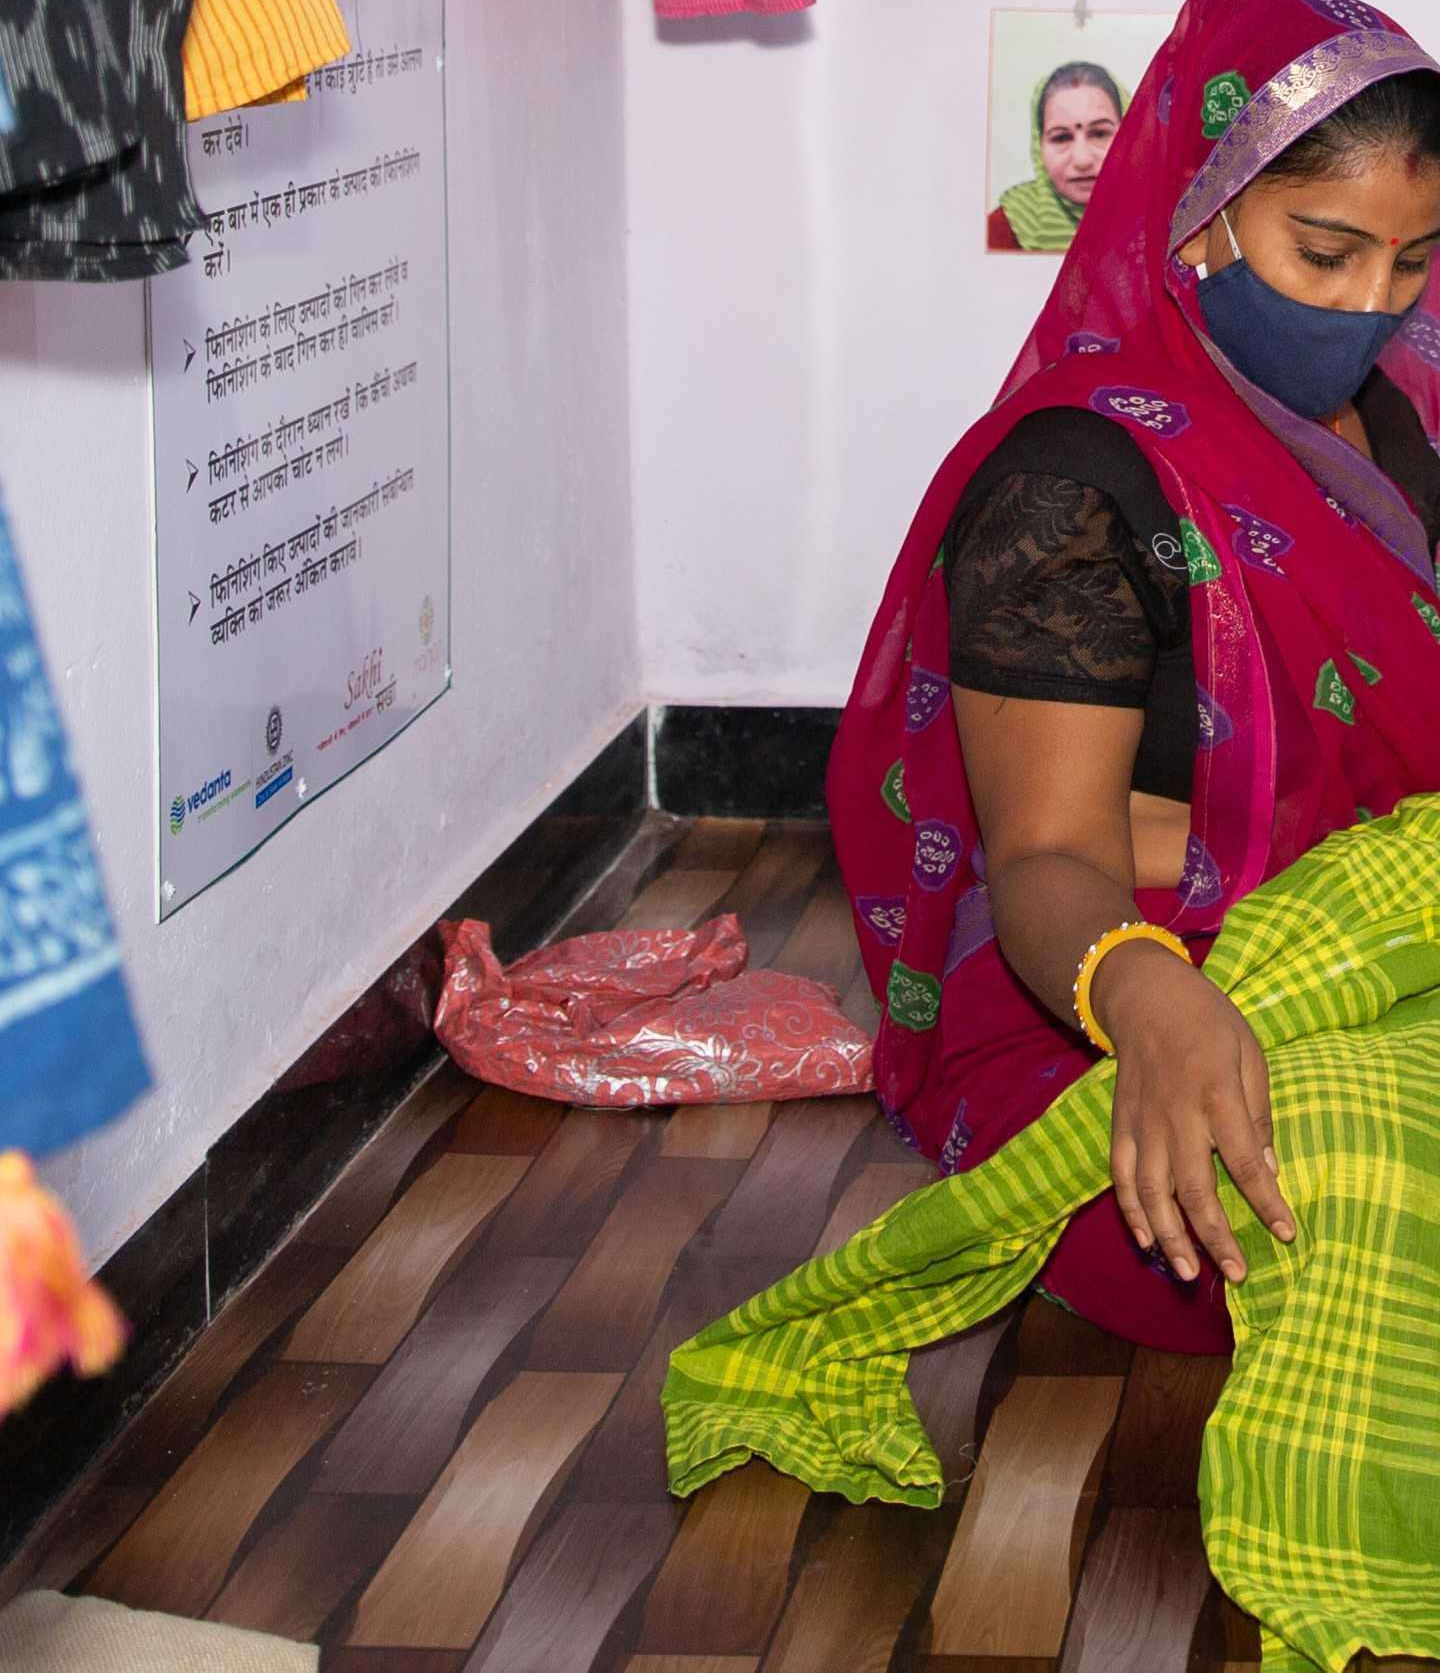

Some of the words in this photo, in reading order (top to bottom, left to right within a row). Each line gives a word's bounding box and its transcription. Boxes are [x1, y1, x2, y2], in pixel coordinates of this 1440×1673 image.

[202, 132, 222, 157] कर
[228, 204, 247, 231] बार
[250, 191, 260, 225] में
[262, 197, 281, 227] एक
[284, 182, 296, 218] ही
[298, 182, 327, 212] प्रकार
[330, 170, 340, 200] के
[369, 157, 381, 186] की
[205, 314, 257, 363] फिनिशिंग
[260, 306, 271, 337] के
[274, 303, 296, 336] लिए
[299, 284, 331, 325] उत्पादों
[333, 279, 347, 311] को
[349, 275, 367, 305] गिन
[368, 271, 382, 296] कर
[207, 355, 257, 404] फिनिशिंग
[261, 345, 271, 378] के
[274, 343, 294, 372] बाद
[298, 333, 316, 364] गिन
[320, 329, 335, 356] कर
[338, 316, 349, 351] ही
[207, 436, 259, 486] फिनिशिंग
[261, 423, 273, 457] के
[276, 415, 304, 451] दौरान
[307, 405, 331, 438] ध्यान
[334, 387, 351, 420] रखें
[355, 383, 368, 413] कि
[209, 490, 236, 525] कटर
[240, 475, 250, 511] से
[252, 454, 288, 501] आपको
[292, 446, 312, 479] चोट
[315, 451, 323, 471] न
[210, 553, 261, 609] फिनिशिंग
[264, 543, 286, 577] किए
[289, 515, 321, 558] उत्पादों
[323, 508, 337, 541] की
[340, 481, 379, 526] जानकारी
[210, 601, 245, 644] व्यक्ति
[248, 588, 263, 624] को
[266, 579, 291, 611] जरूर
[294, 557, 327, 594] अंकित
[343, 647, 384, 710] Sakhi
[186, 767, 232, 813] vedanta
